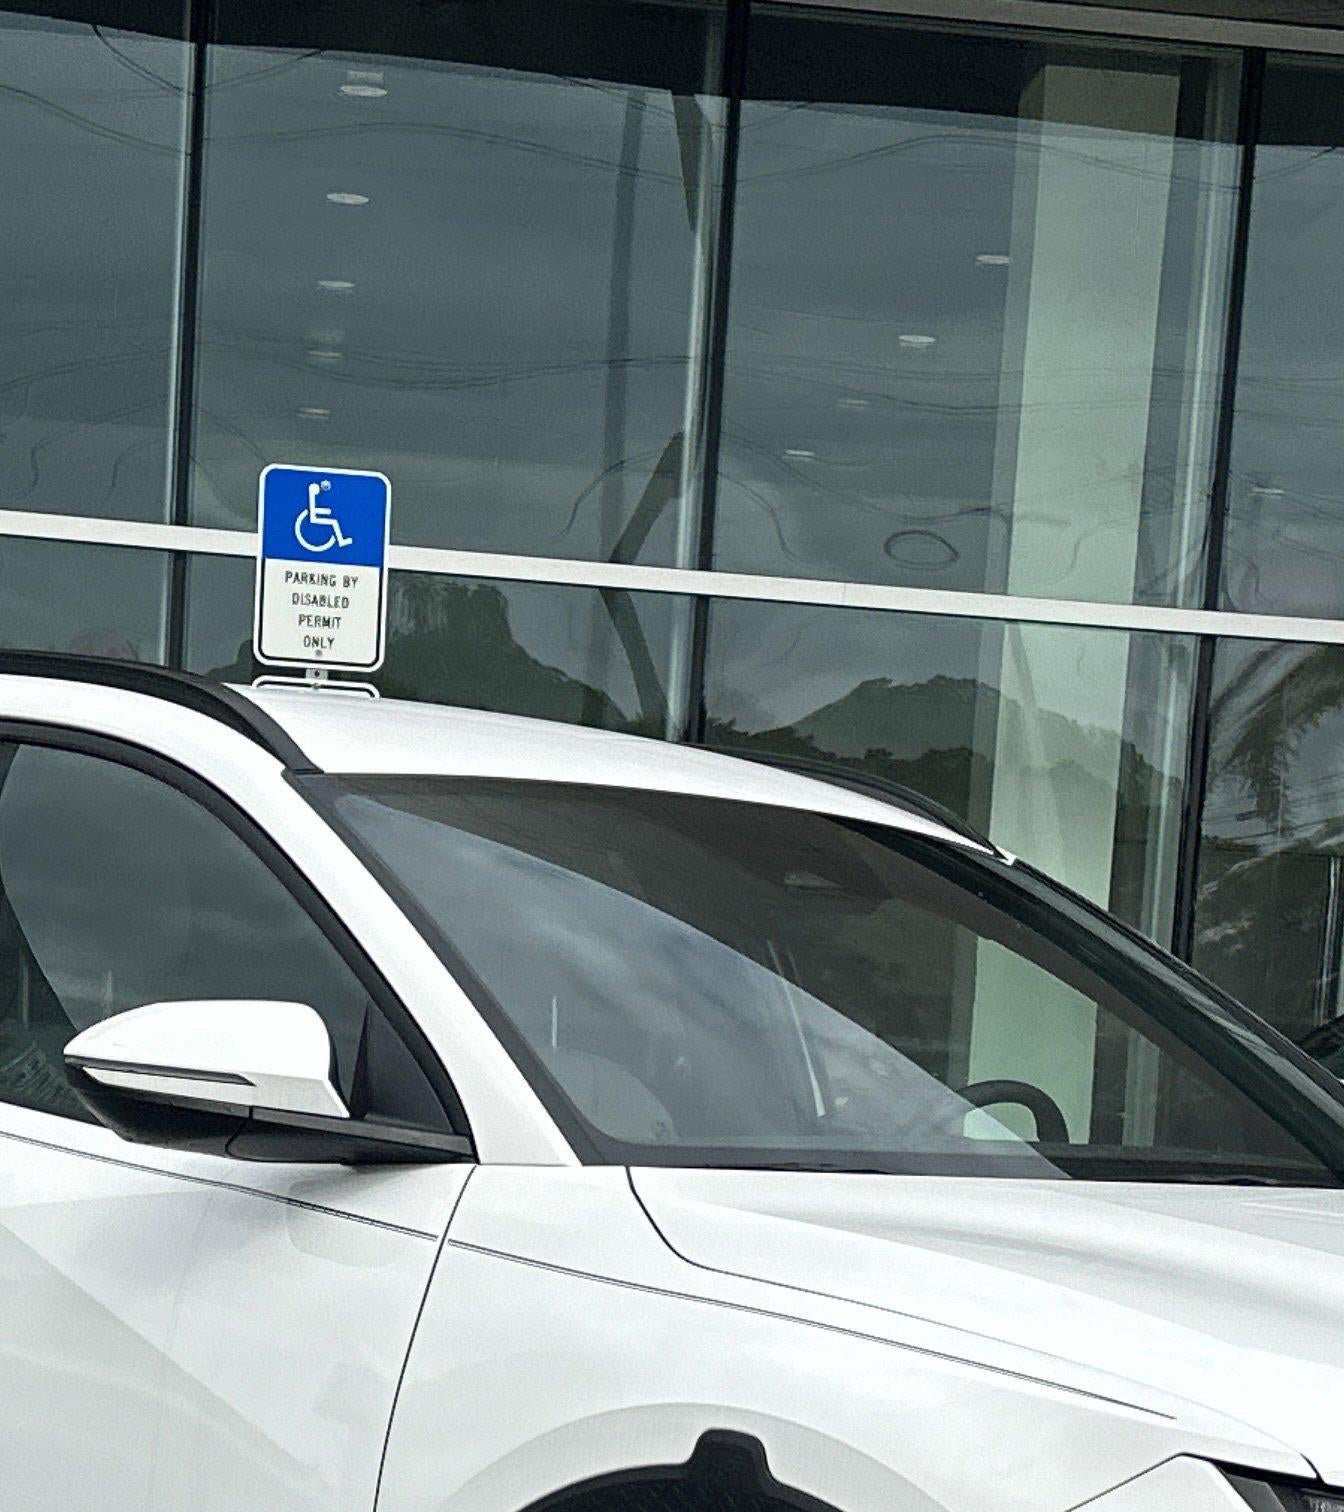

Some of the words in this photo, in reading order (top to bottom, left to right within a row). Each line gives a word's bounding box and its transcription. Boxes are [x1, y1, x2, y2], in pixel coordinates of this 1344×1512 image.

[285, 570, 336, 587] PARKING
[342, 574, 359, 588] BY
[292, 592, 350, 609] DISABLED
[298, 613, 342, 630] PERMIT
[303, 633, 335, 649] ONLY
